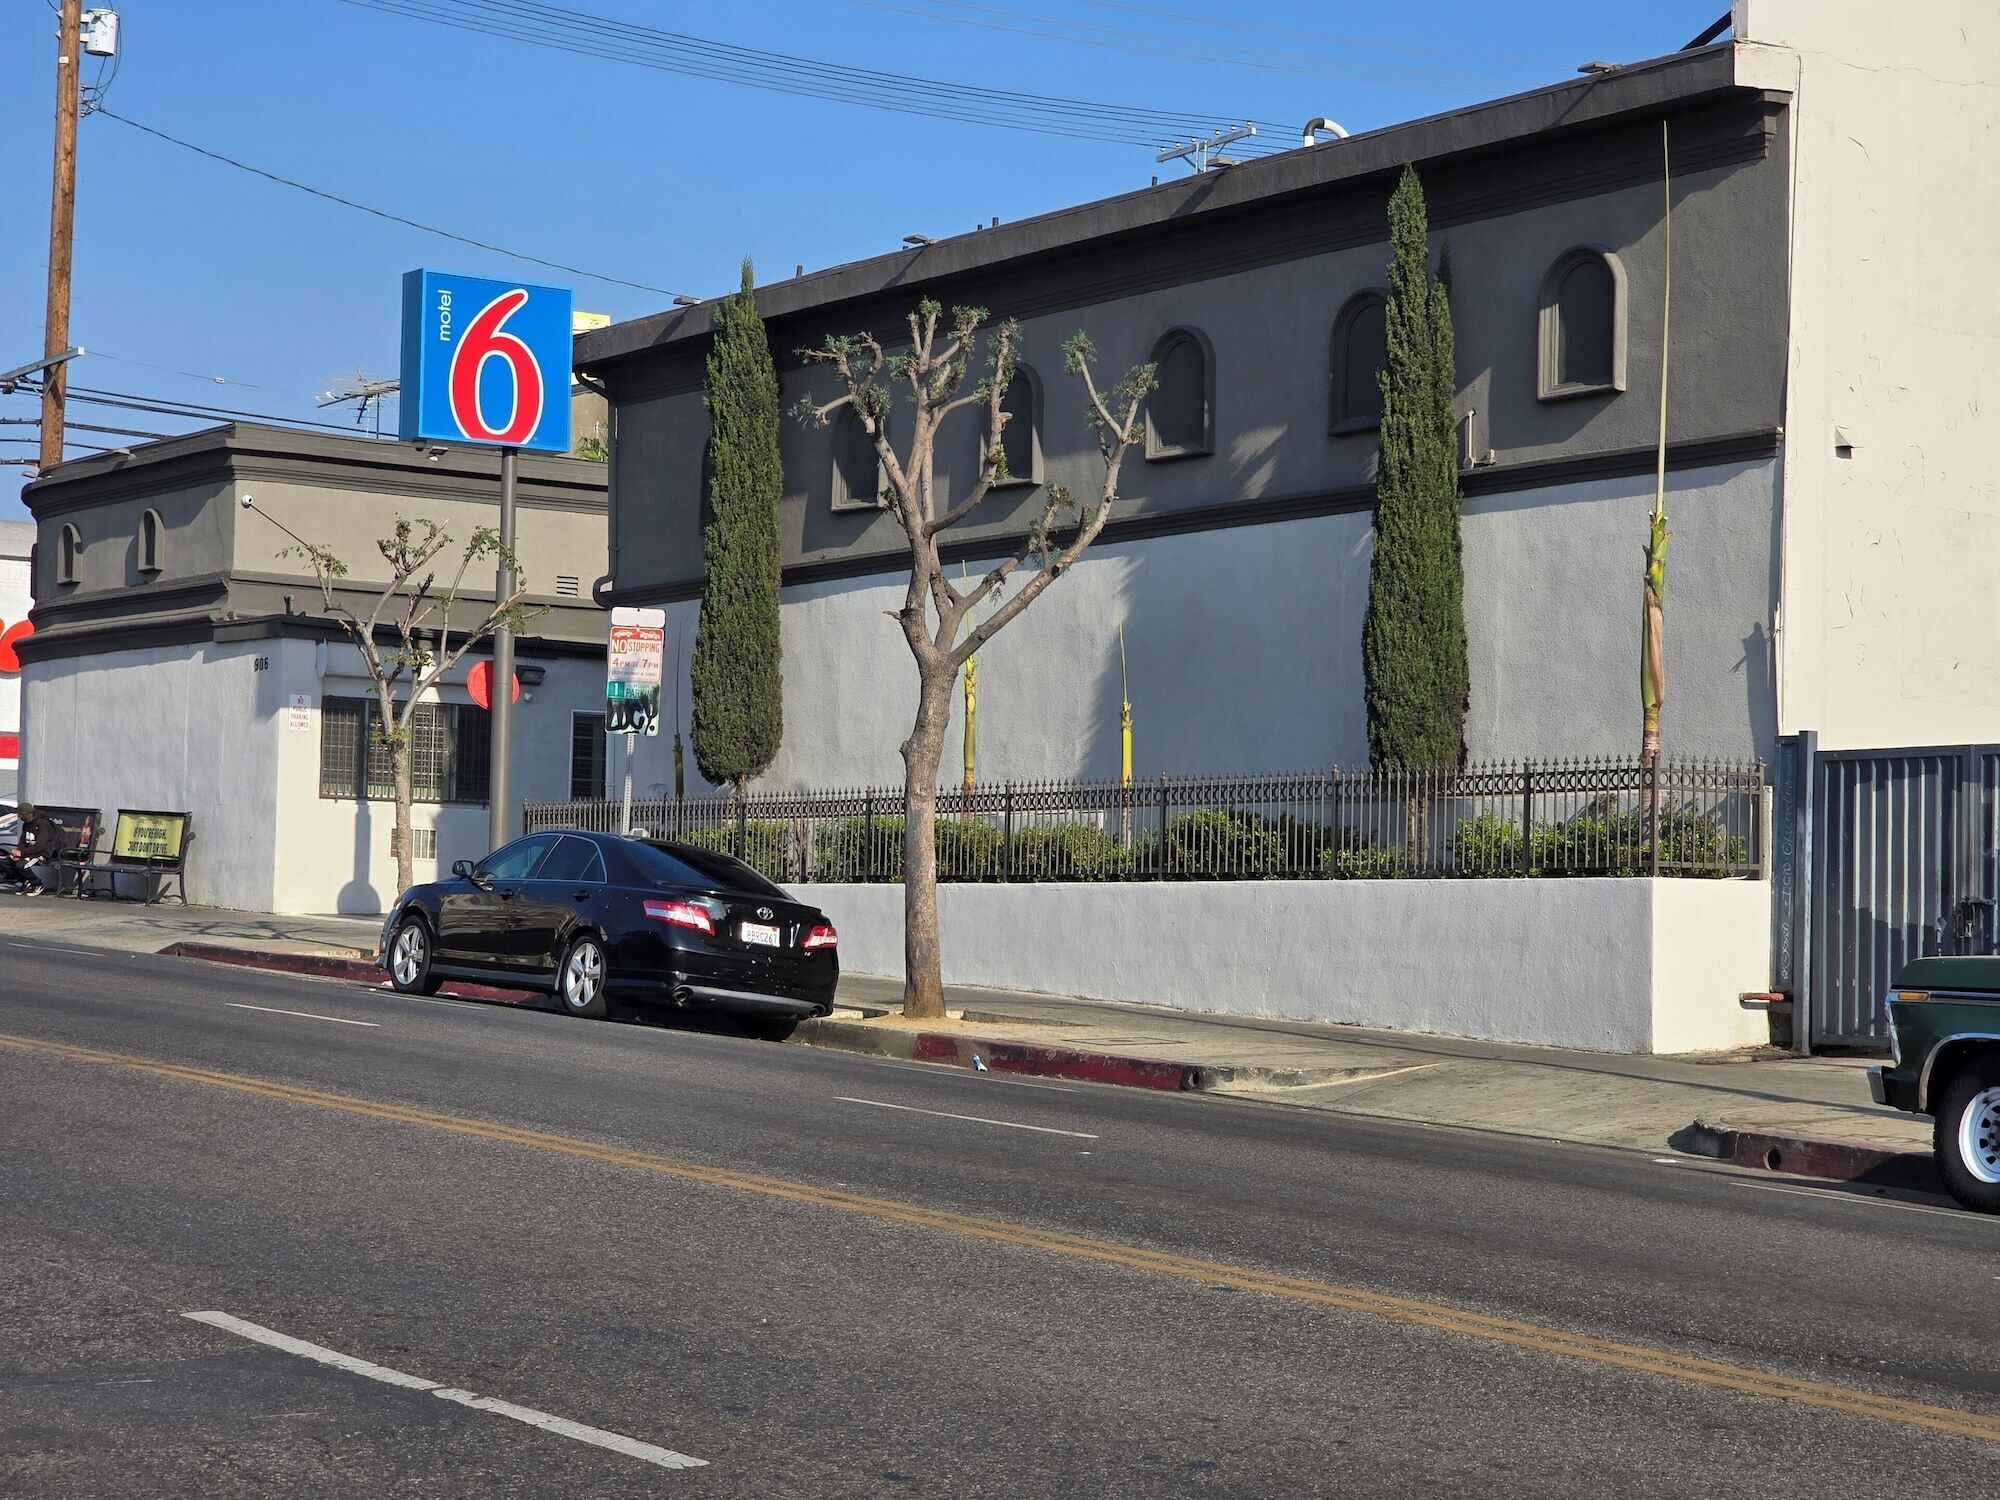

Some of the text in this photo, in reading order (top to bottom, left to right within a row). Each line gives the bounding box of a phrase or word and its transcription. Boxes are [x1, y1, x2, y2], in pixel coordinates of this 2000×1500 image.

[437, 288, 544, 444] motel 6
[611, 639, 660, 653] NO STOPPING
[254, 657, 269, 672] 906
[297, 697, 305, 705] NO
[289, 721, 309, 729] ALLOWED
